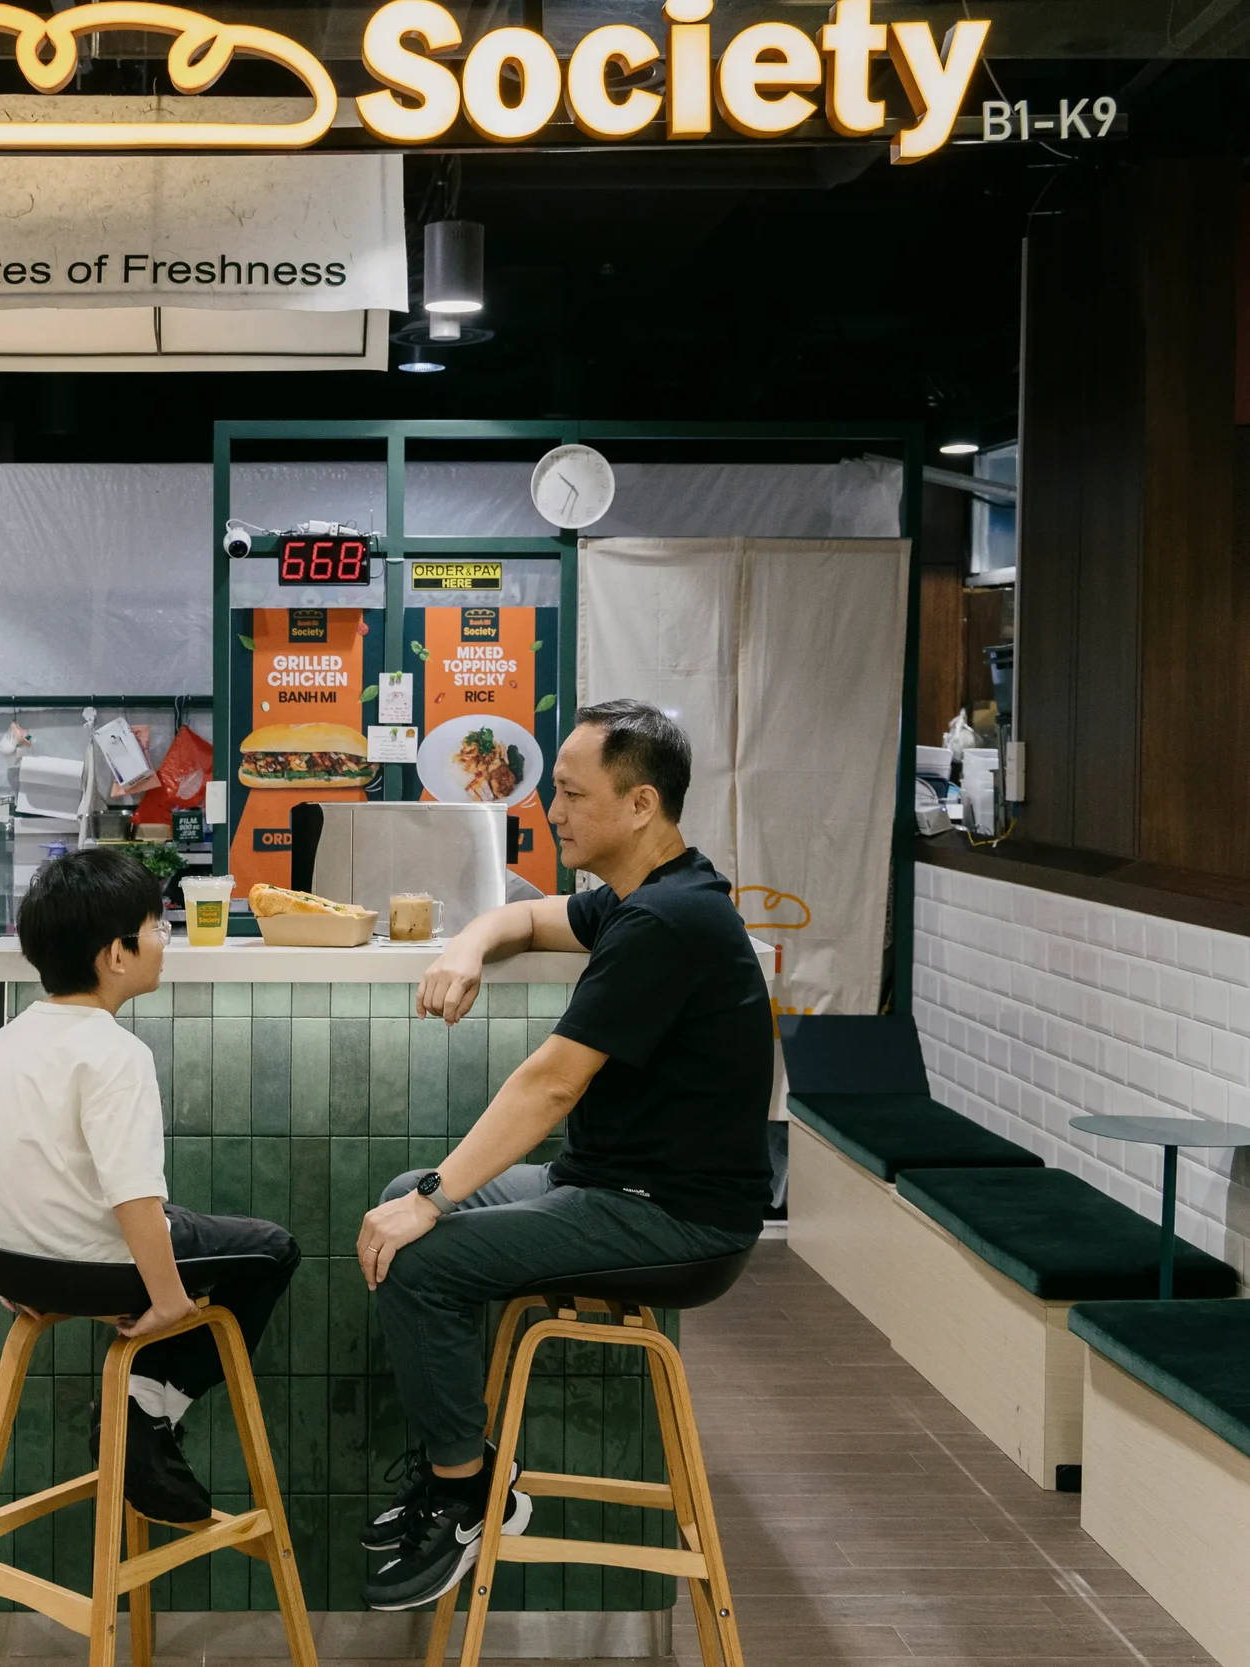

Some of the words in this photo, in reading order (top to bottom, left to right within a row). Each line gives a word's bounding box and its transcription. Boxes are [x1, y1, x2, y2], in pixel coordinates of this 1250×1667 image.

[355, 0, 992, 164] Society
[981, 96, 1117, 142] B1-K9
[67, 254, 109, 285] of
[123, 254, 347, 287] Freshness
[282, 542, 363, 579] 668
[414, 565, 464, 576] ORDER
[465, 568, 472, 576] &
[473, 565, 499, 576] PAY
[441, 578, 473, 588] HERE
[291, 628, 325, 637] Society
[463, 627, 497, 637] Society
[456, 646, 504, 659] MIXED
[273, 655, 343, 671] GRILLED
[443, 659, 517, 673] TOPPINGS
[267, 671, 348, 687] CHICKEN
[454, 673, 506, 687] STICKY
[278, 691, 318, 703] BANH
[320, 691, 337, 703] MI
[464, 690, 495, 703] RICE
[261, 832, 292, 846] ORD
